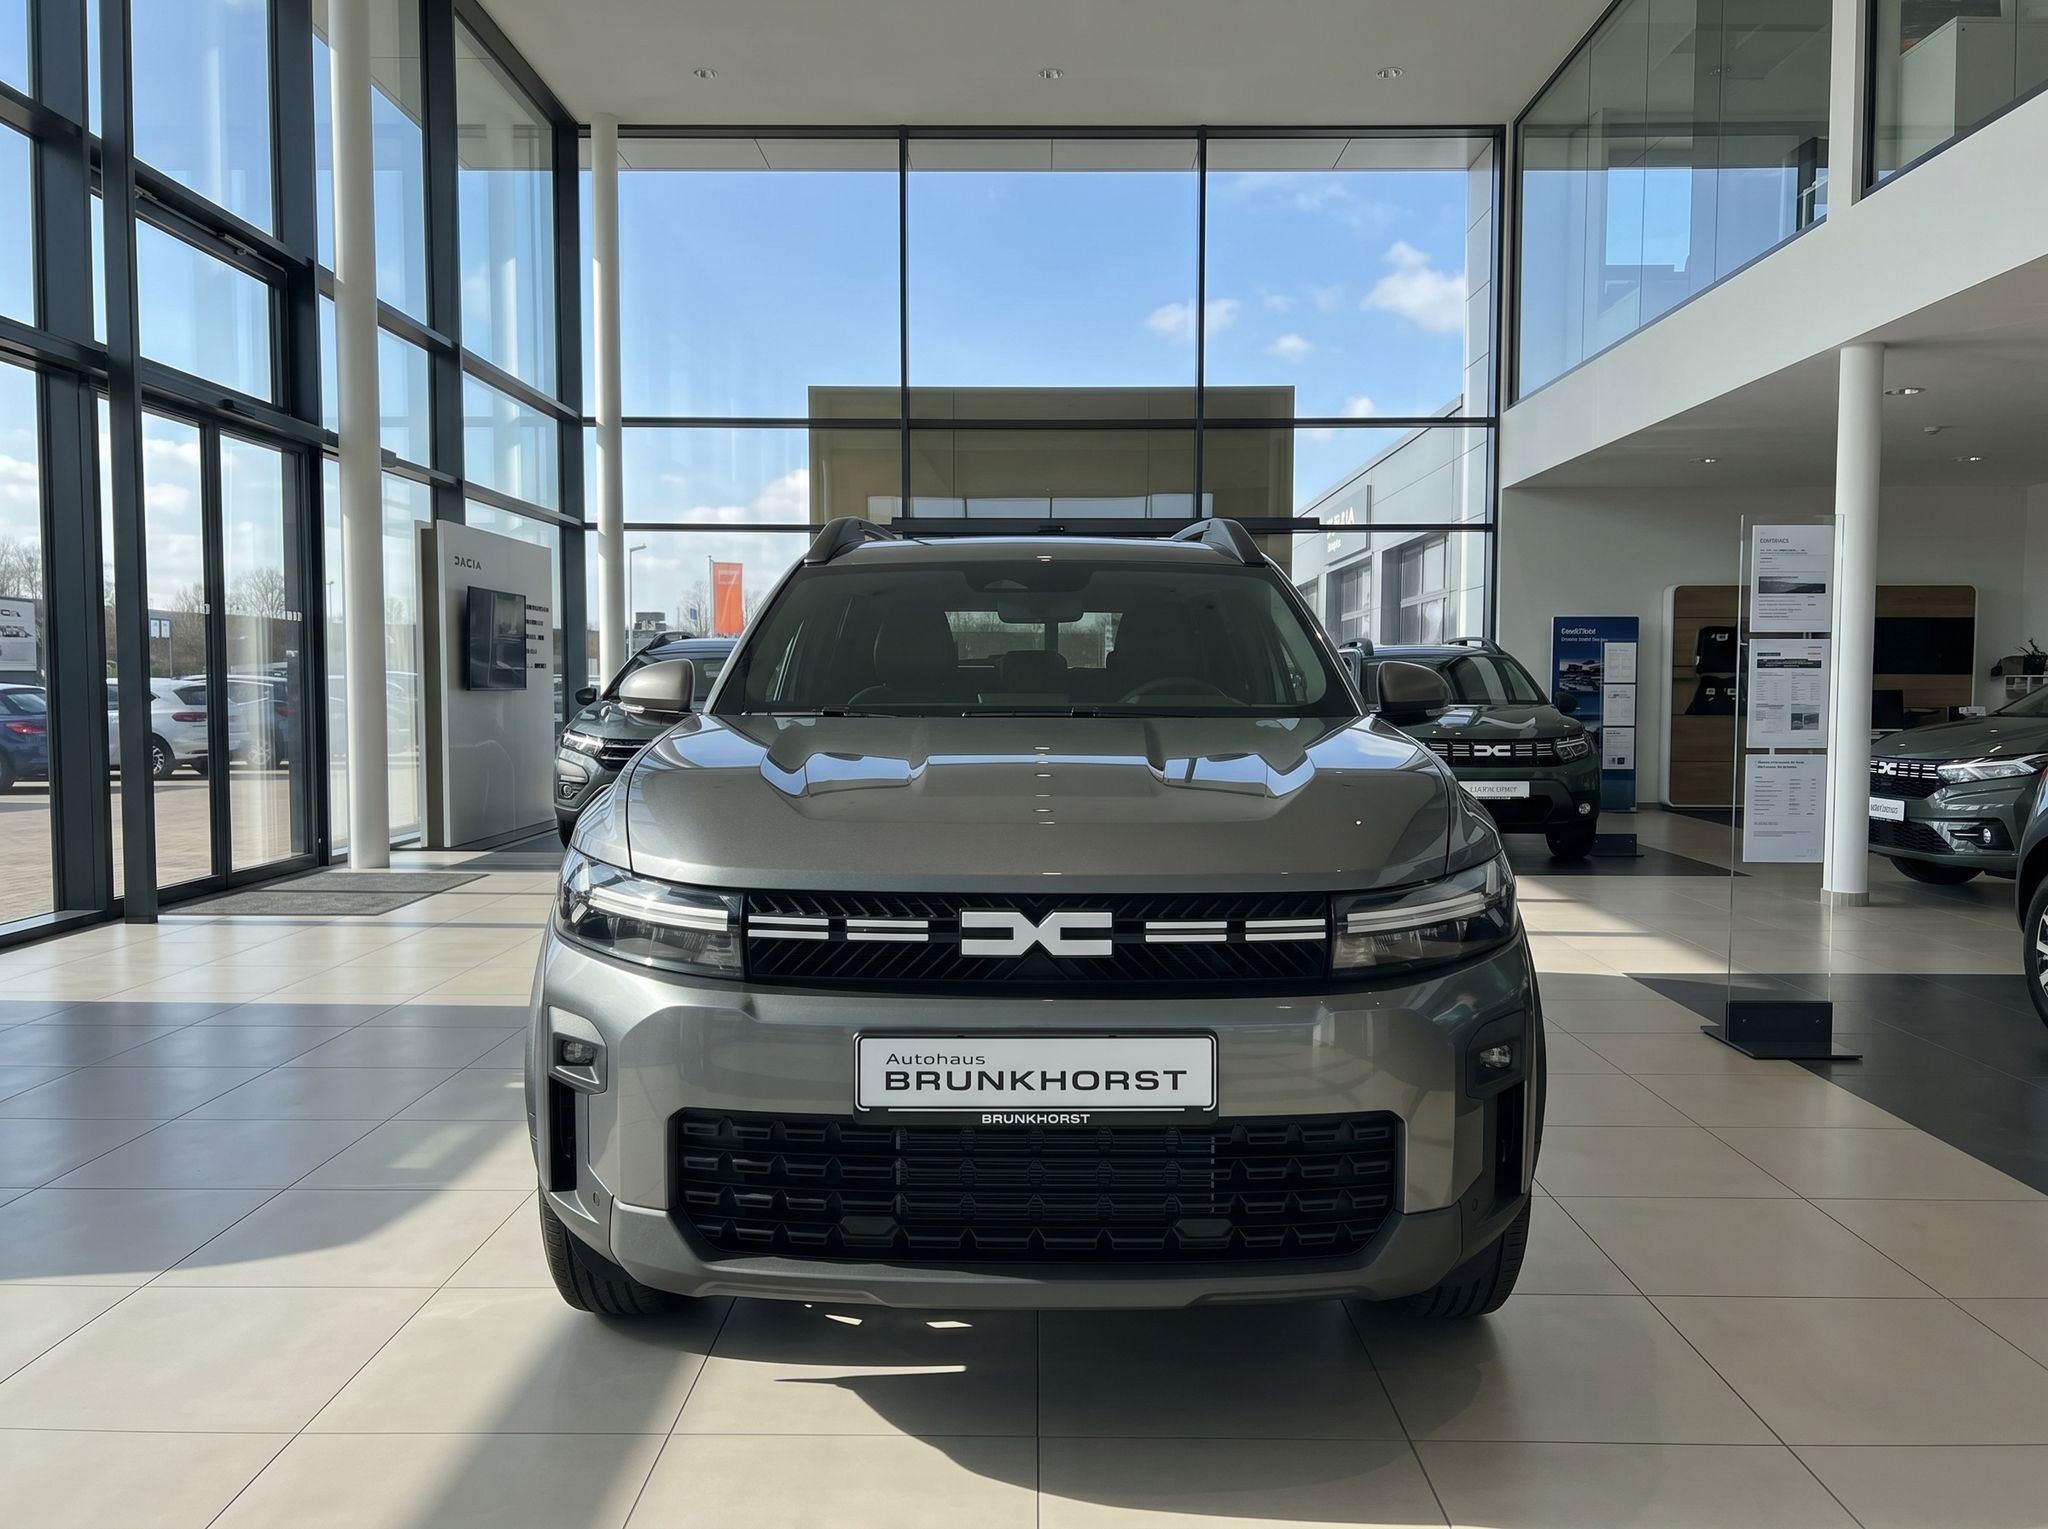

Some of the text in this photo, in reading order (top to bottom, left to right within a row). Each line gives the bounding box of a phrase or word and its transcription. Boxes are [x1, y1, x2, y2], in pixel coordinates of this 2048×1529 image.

[454, 555, 482, 571] DACIA
[885, 1052, 986, 1066] Autohaus
[884, 1069, 1188, 1092] BRUNKHORST
[981, 1113, 1091, 1125] BRUNKHORST
